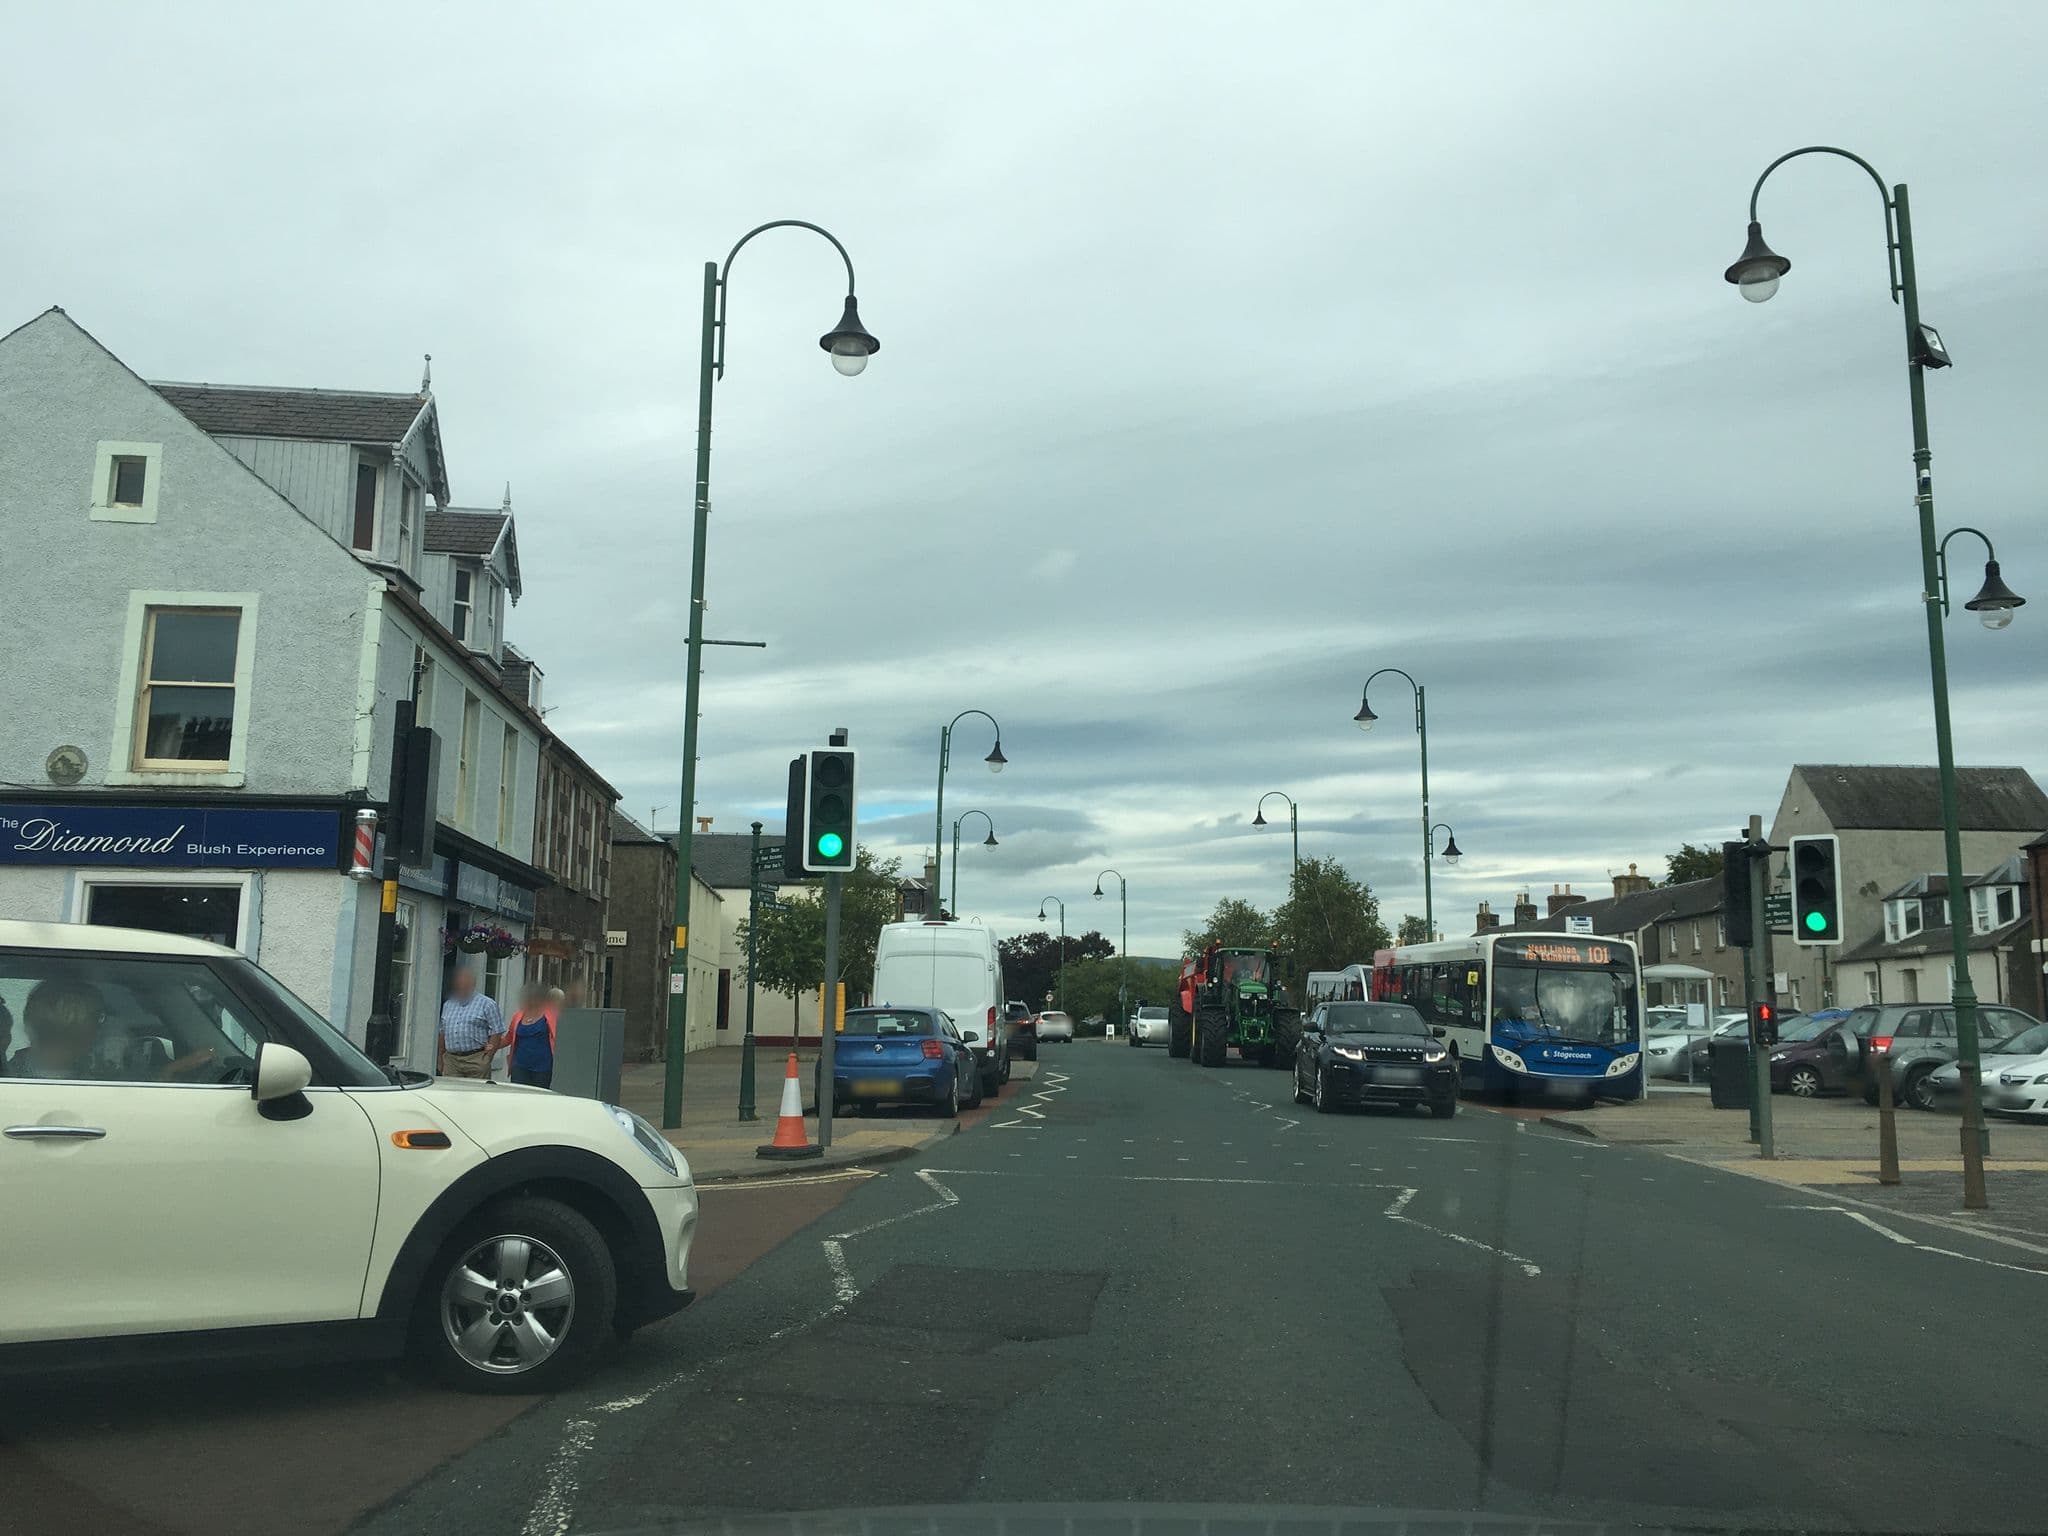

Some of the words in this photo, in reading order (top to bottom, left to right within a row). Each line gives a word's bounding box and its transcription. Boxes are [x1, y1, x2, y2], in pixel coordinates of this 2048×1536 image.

[0, 817, 19, 829] he
[14, 818, 186, 854] Diamond
[186, 843, 231, 854] Blush
[237, 844, 326, 857] Experience
[1549, 945, 1577, 954] Linton
[1588, 946, 1610, 964] 101
[1553, 1050, 1591, 1060] Stagecoach
